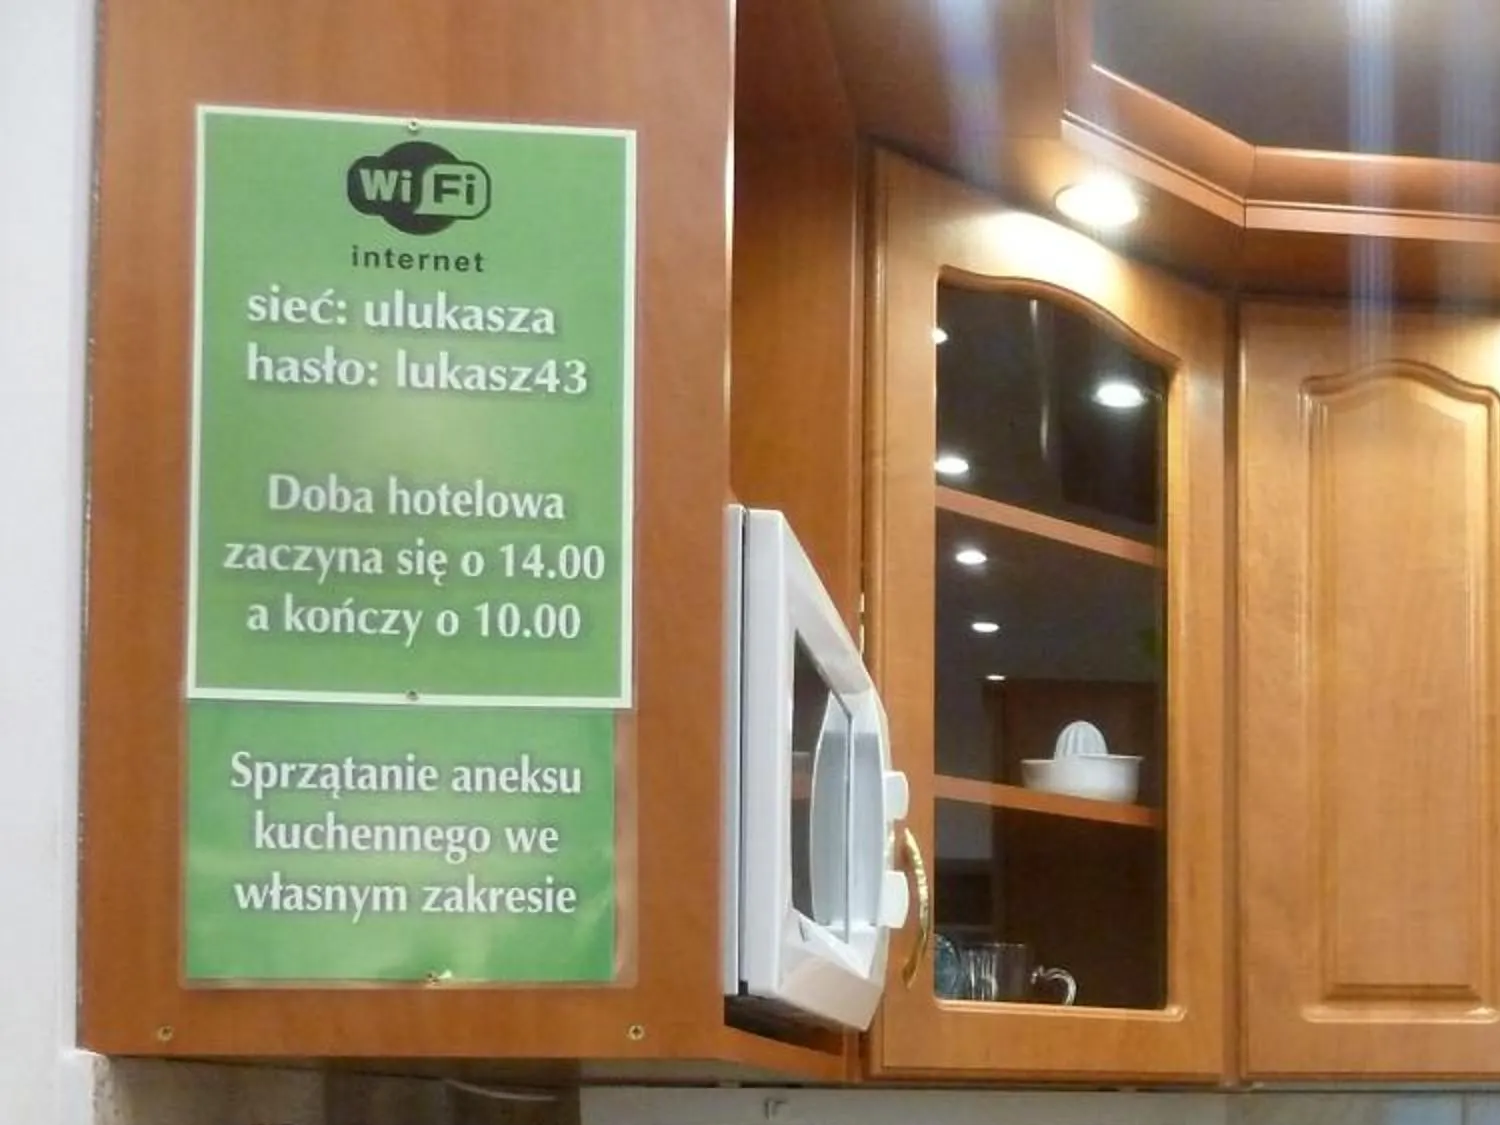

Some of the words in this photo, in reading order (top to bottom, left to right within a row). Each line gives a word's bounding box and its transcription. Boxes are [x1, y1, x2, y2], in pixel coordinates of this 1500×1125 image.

[351, 244, 485, 273] internet
[247, 284, 348, 326] sieć:
[364, 289, 556, 335] ulukasza
[247, 341, 379, 388] hasło:
[397, 348, 588, 395] lukasz43
[268, 473, 374, 514] Doba
[388, 475, 565, 520] hotelowa
[222, 541, 383, 585] zaczyna
[396, 537, 448, 586] się
[460, 550, 485, 577] o
[499, 543, 605, 579] 14.00
[246, 603, 270, 632] a
[283, 592, 423, 648] kończy
[436, 609, 460, 638] o
[474, 602, 581, 639] 10.00
[229, 751, 439, 799] Sprzątanie
[450, 754, 582, 794] aneksu
[254, 809, 492, 865] kuchennego
[505, 826, 560, 853] we
[233, 872, 407, 923] własnym
[421, 874, 577, 913] zakresie
